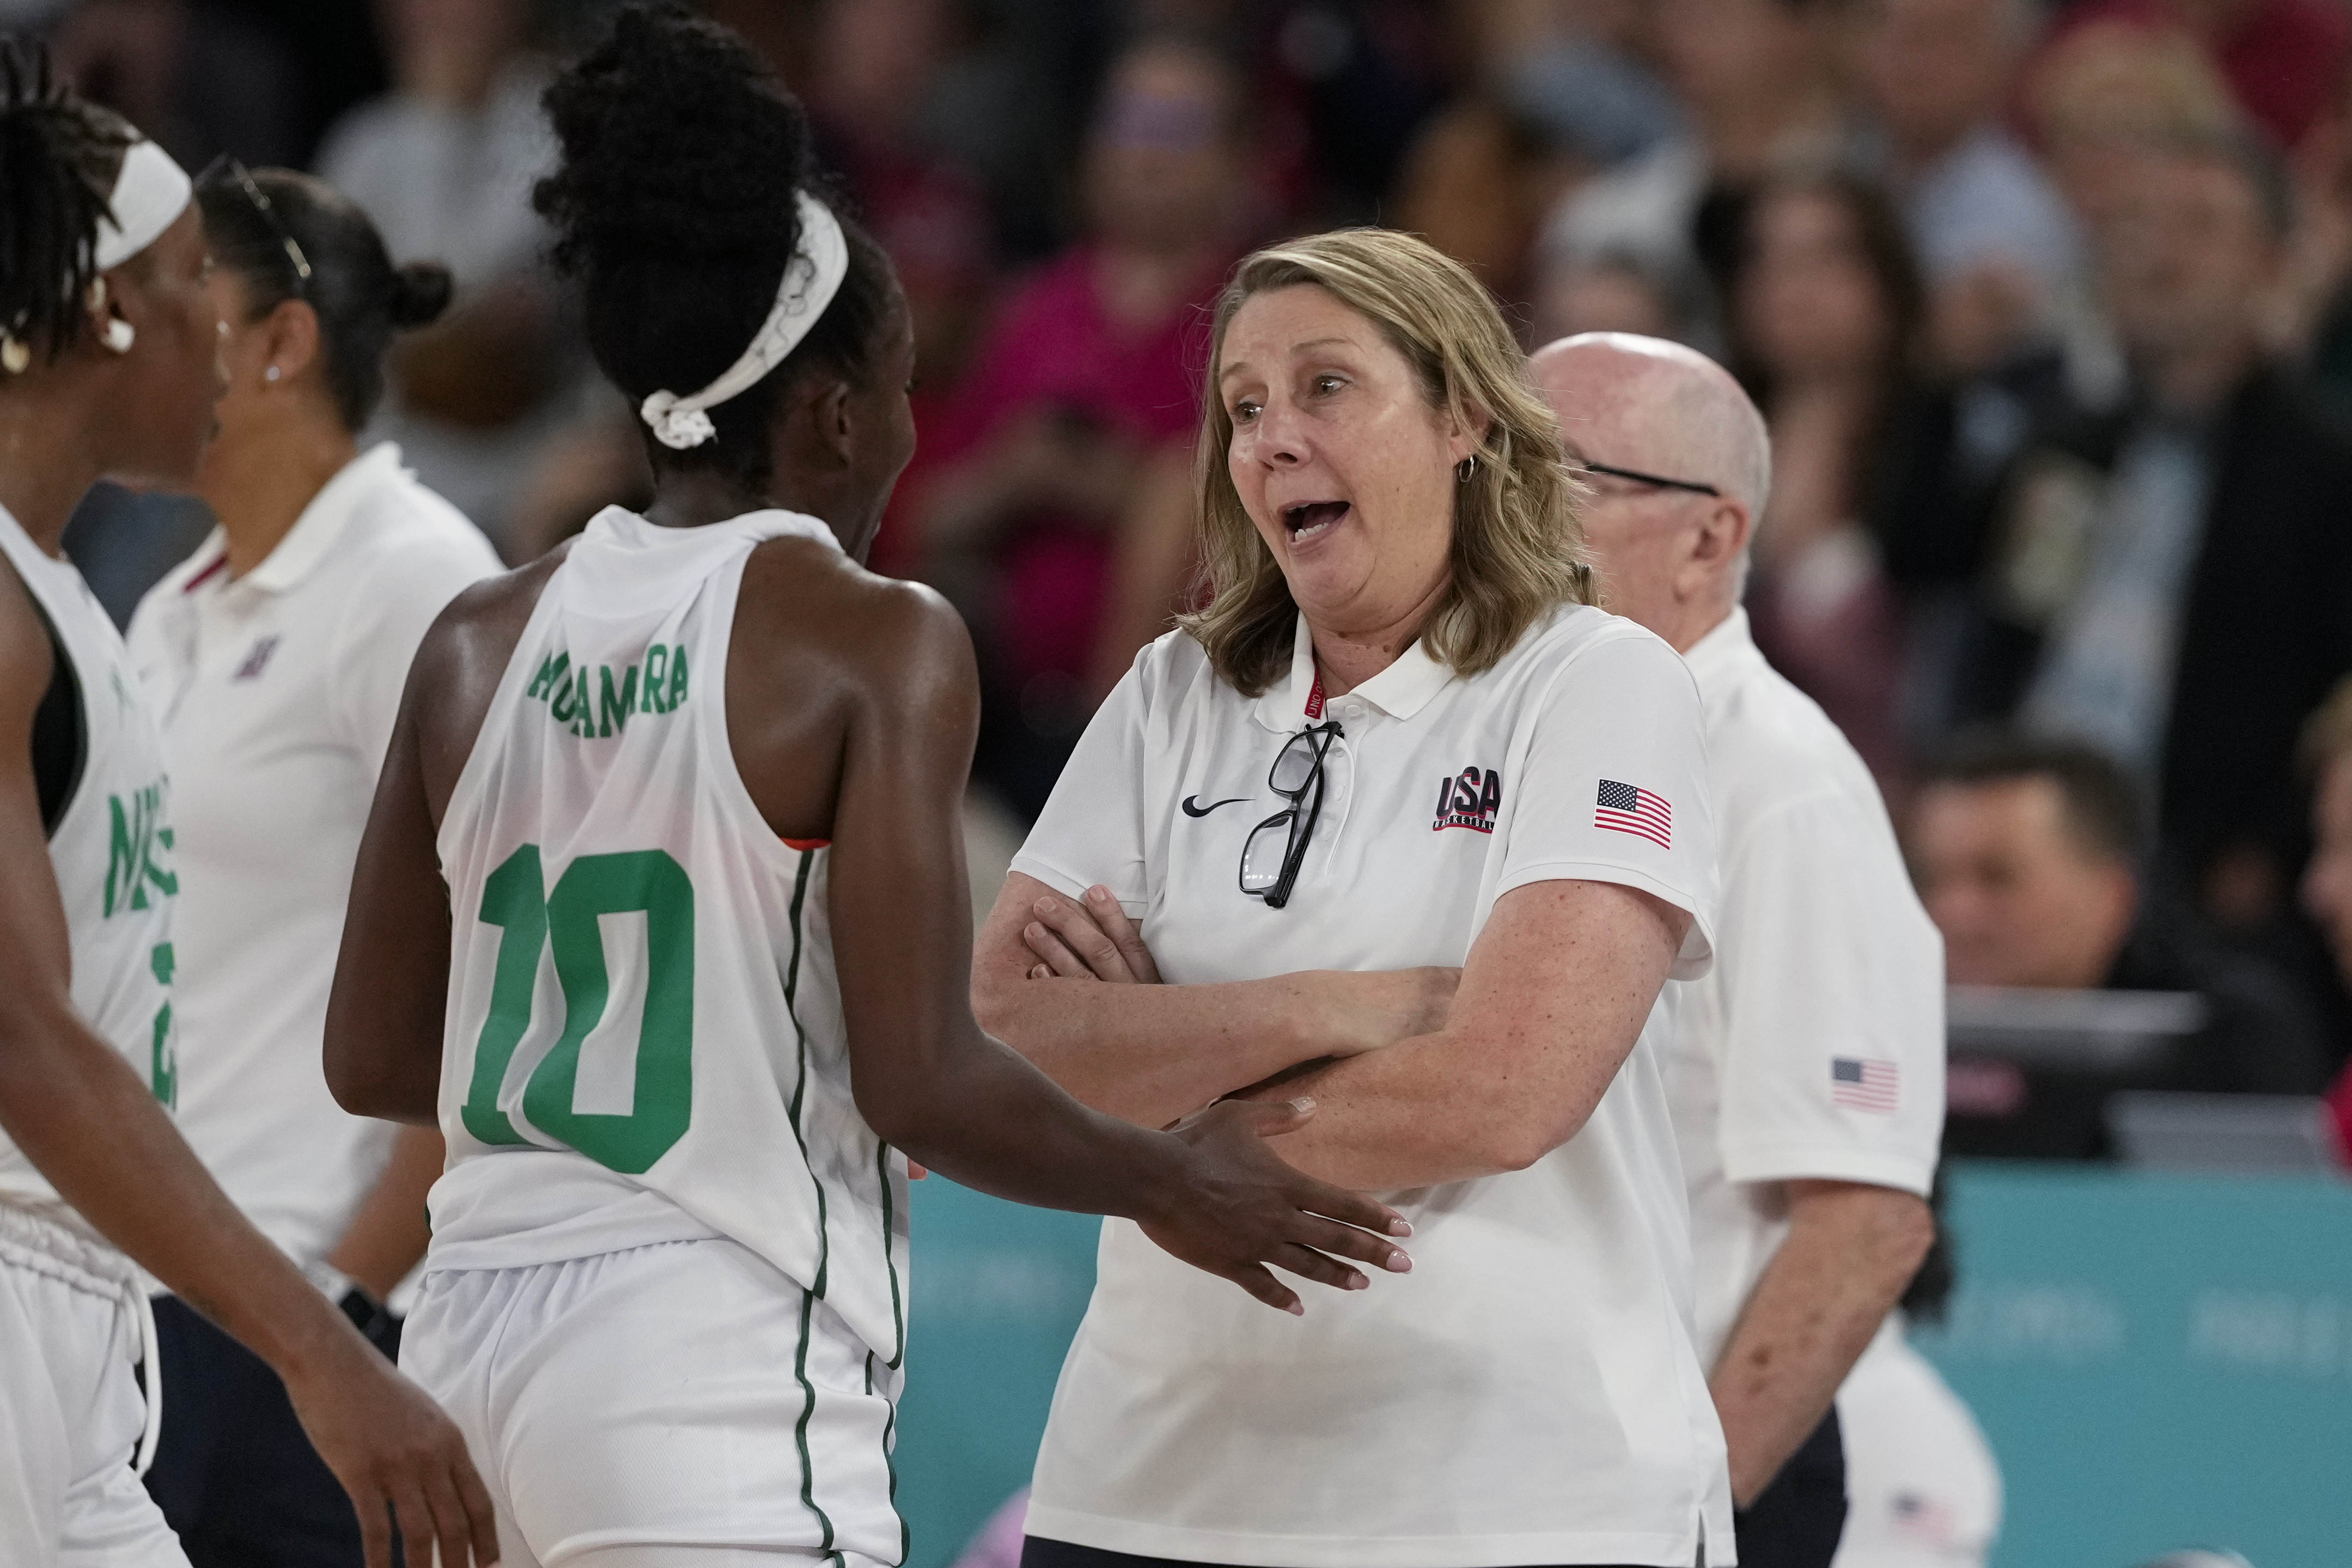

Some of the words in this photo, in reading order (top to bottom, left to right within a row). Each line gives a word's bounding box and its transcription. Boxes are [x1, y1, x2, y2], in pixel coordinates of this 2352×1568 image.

[1307, 694, 1321, 716] UNO
[1436, 766, 1501, 820] USA
[1434, 815, 1494, 830] BASKETBAL
[461, 843, 694, 1174] 10
